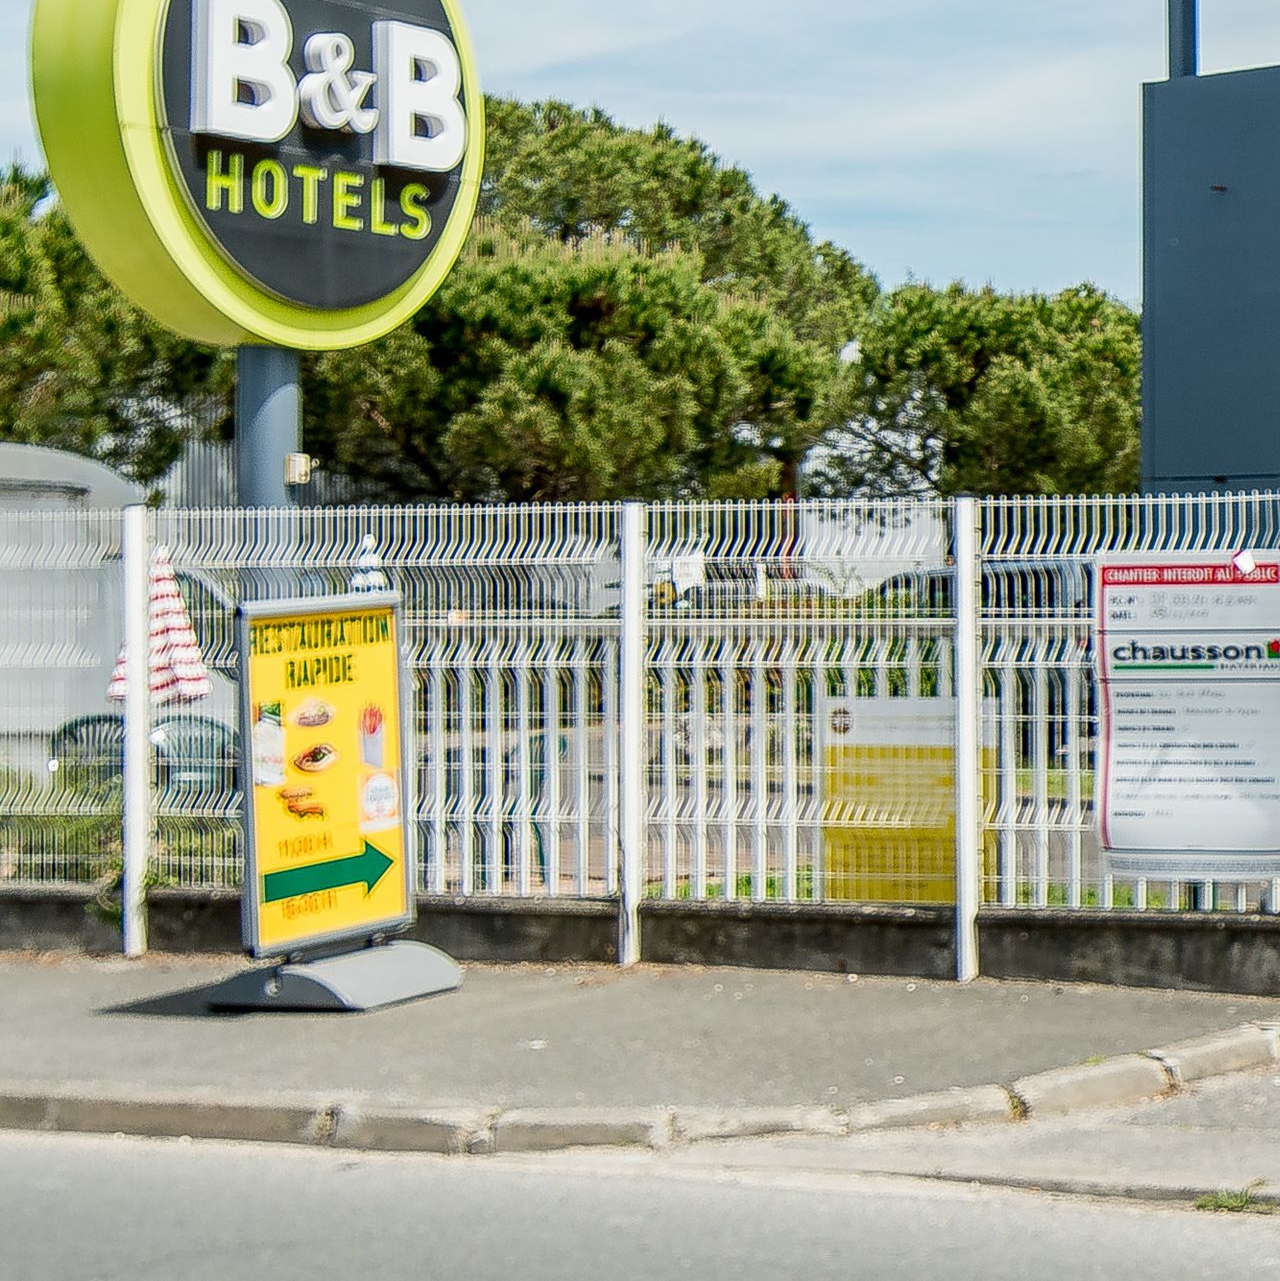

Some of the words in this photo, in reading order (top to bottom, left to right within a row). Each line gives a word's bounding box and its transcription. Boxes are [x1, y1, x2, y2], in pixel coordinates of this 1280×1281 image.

[206, 150, 432, 241] HOTELS
[1162, 568, 1214, 582] INTERDIT
[1215, 567, 1233, 582] AU
[249, 615, 390, 655] RESTAURATION
[1112, 639, 1263, 661] chausson
[286, 653, 354, 689] RAPIDE
